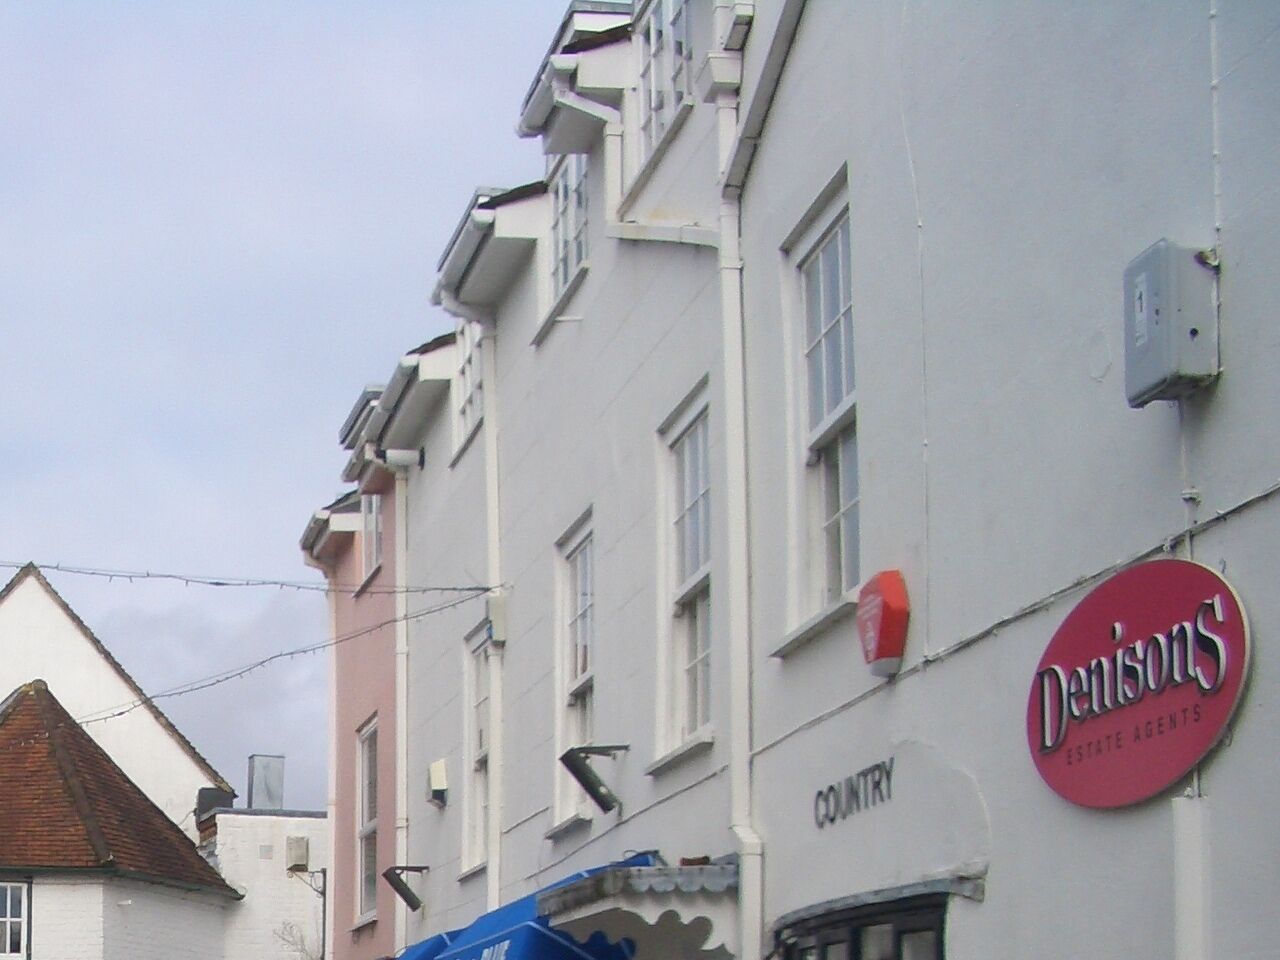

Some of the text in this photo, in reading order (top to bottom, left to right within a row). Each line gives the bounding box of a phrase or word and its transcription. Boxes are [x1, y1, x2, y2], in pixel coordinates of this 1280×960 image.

[1066, 703, 1202, 766] ESTATE AGENTS
[814, 756, 895, 830] COUNTRY
